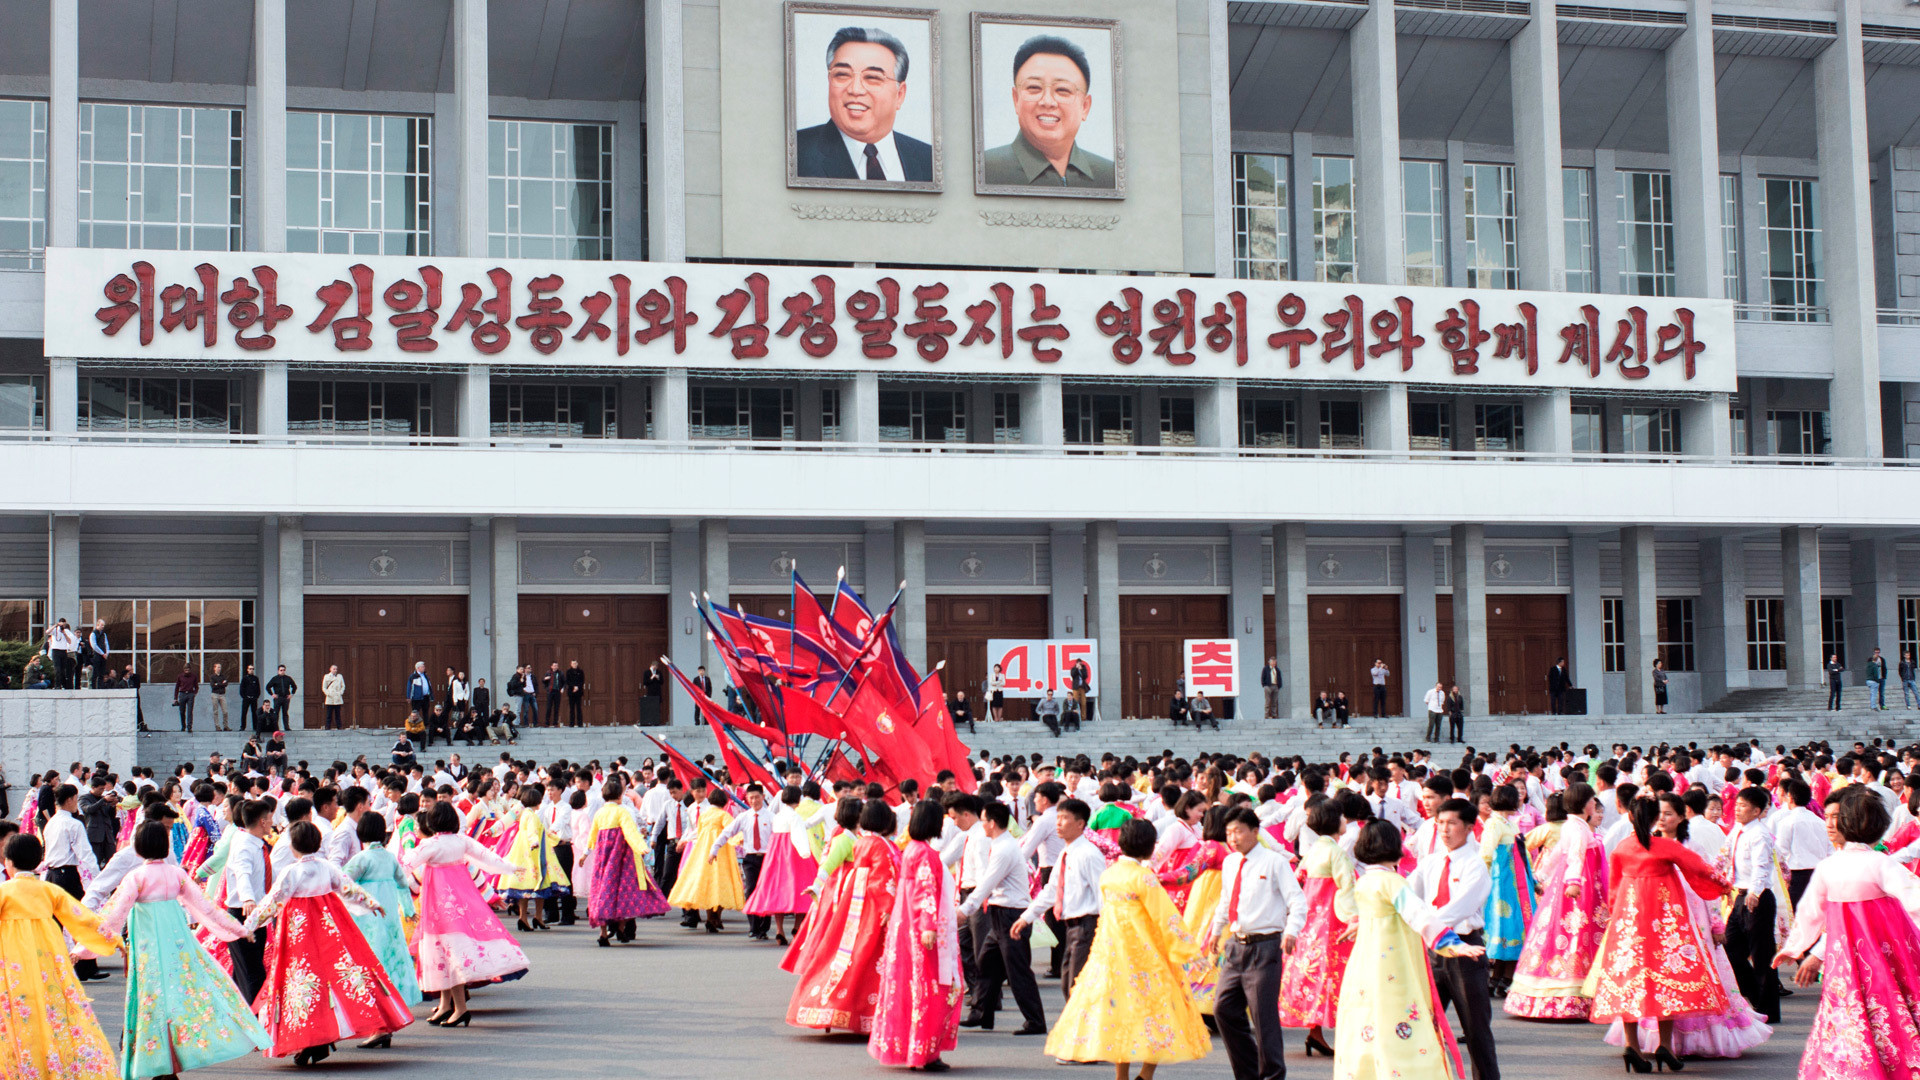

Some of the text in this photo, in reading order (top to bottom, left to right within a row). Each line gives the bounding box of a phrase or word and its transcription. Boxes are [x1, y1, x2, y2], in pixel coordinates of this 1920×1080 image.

[96, 261, 1706, 380] 위대한 김일성동지와 김정일동지는 영원히 우리와 함께 계신다
[1001, 645, 1092, 693] 4.15
[1191, 642, 1234, 692] 축
